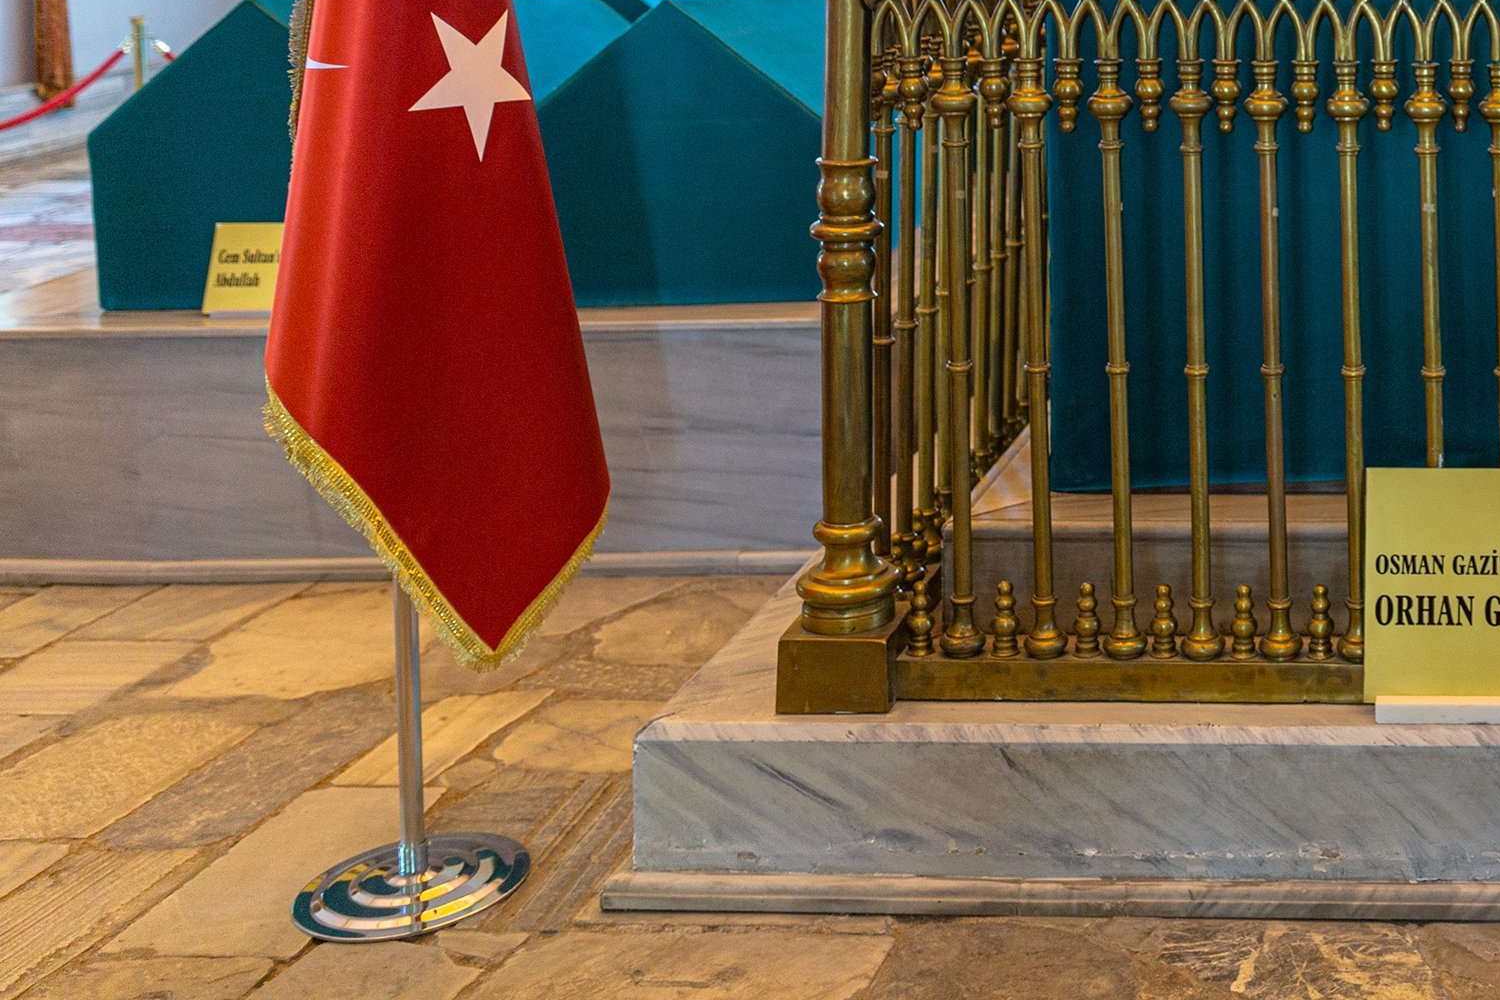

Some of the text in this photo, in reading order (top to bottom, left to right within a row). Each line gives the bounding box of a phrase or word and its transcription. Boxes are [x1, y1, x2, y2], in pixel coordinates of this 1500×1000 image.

[215, 272, 260, 288] Abdullah
[1375, 554, 1445, 576] OSMAN
[1375, 594, 1475, 627] ORHAN
